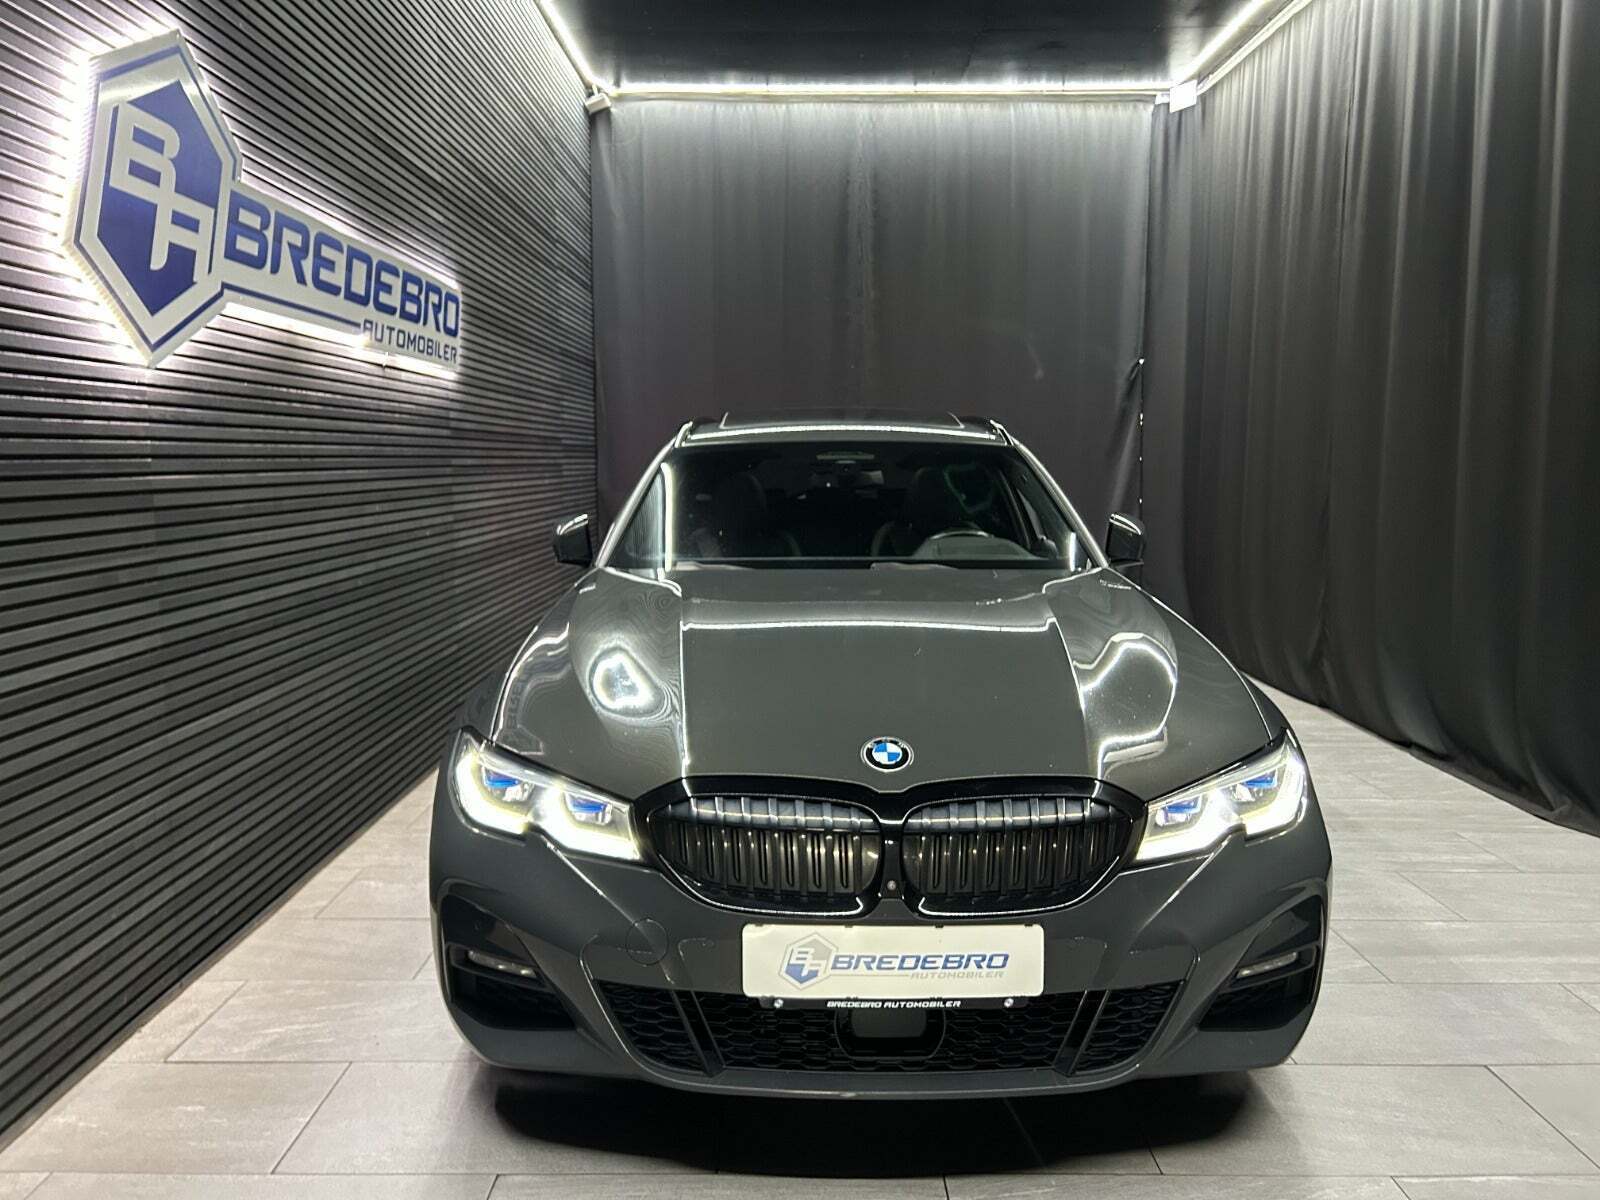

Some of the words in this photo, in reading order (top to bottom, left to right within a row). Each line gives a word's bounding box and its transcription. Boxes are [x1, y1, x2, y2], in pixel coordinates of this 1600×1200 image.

[224, 190, 461, 337] BREDEBRO
[362, 319, 458, 362] AUTOMOBILER
[831, 953, 1009, 970] BREDEBRO
[910, 972, 1004, 980] AUTOMOBILER
[826, 1000, 882, 1008] BREDEBRO
[883, 1000, 961, 1008] AUTOMOBILER
